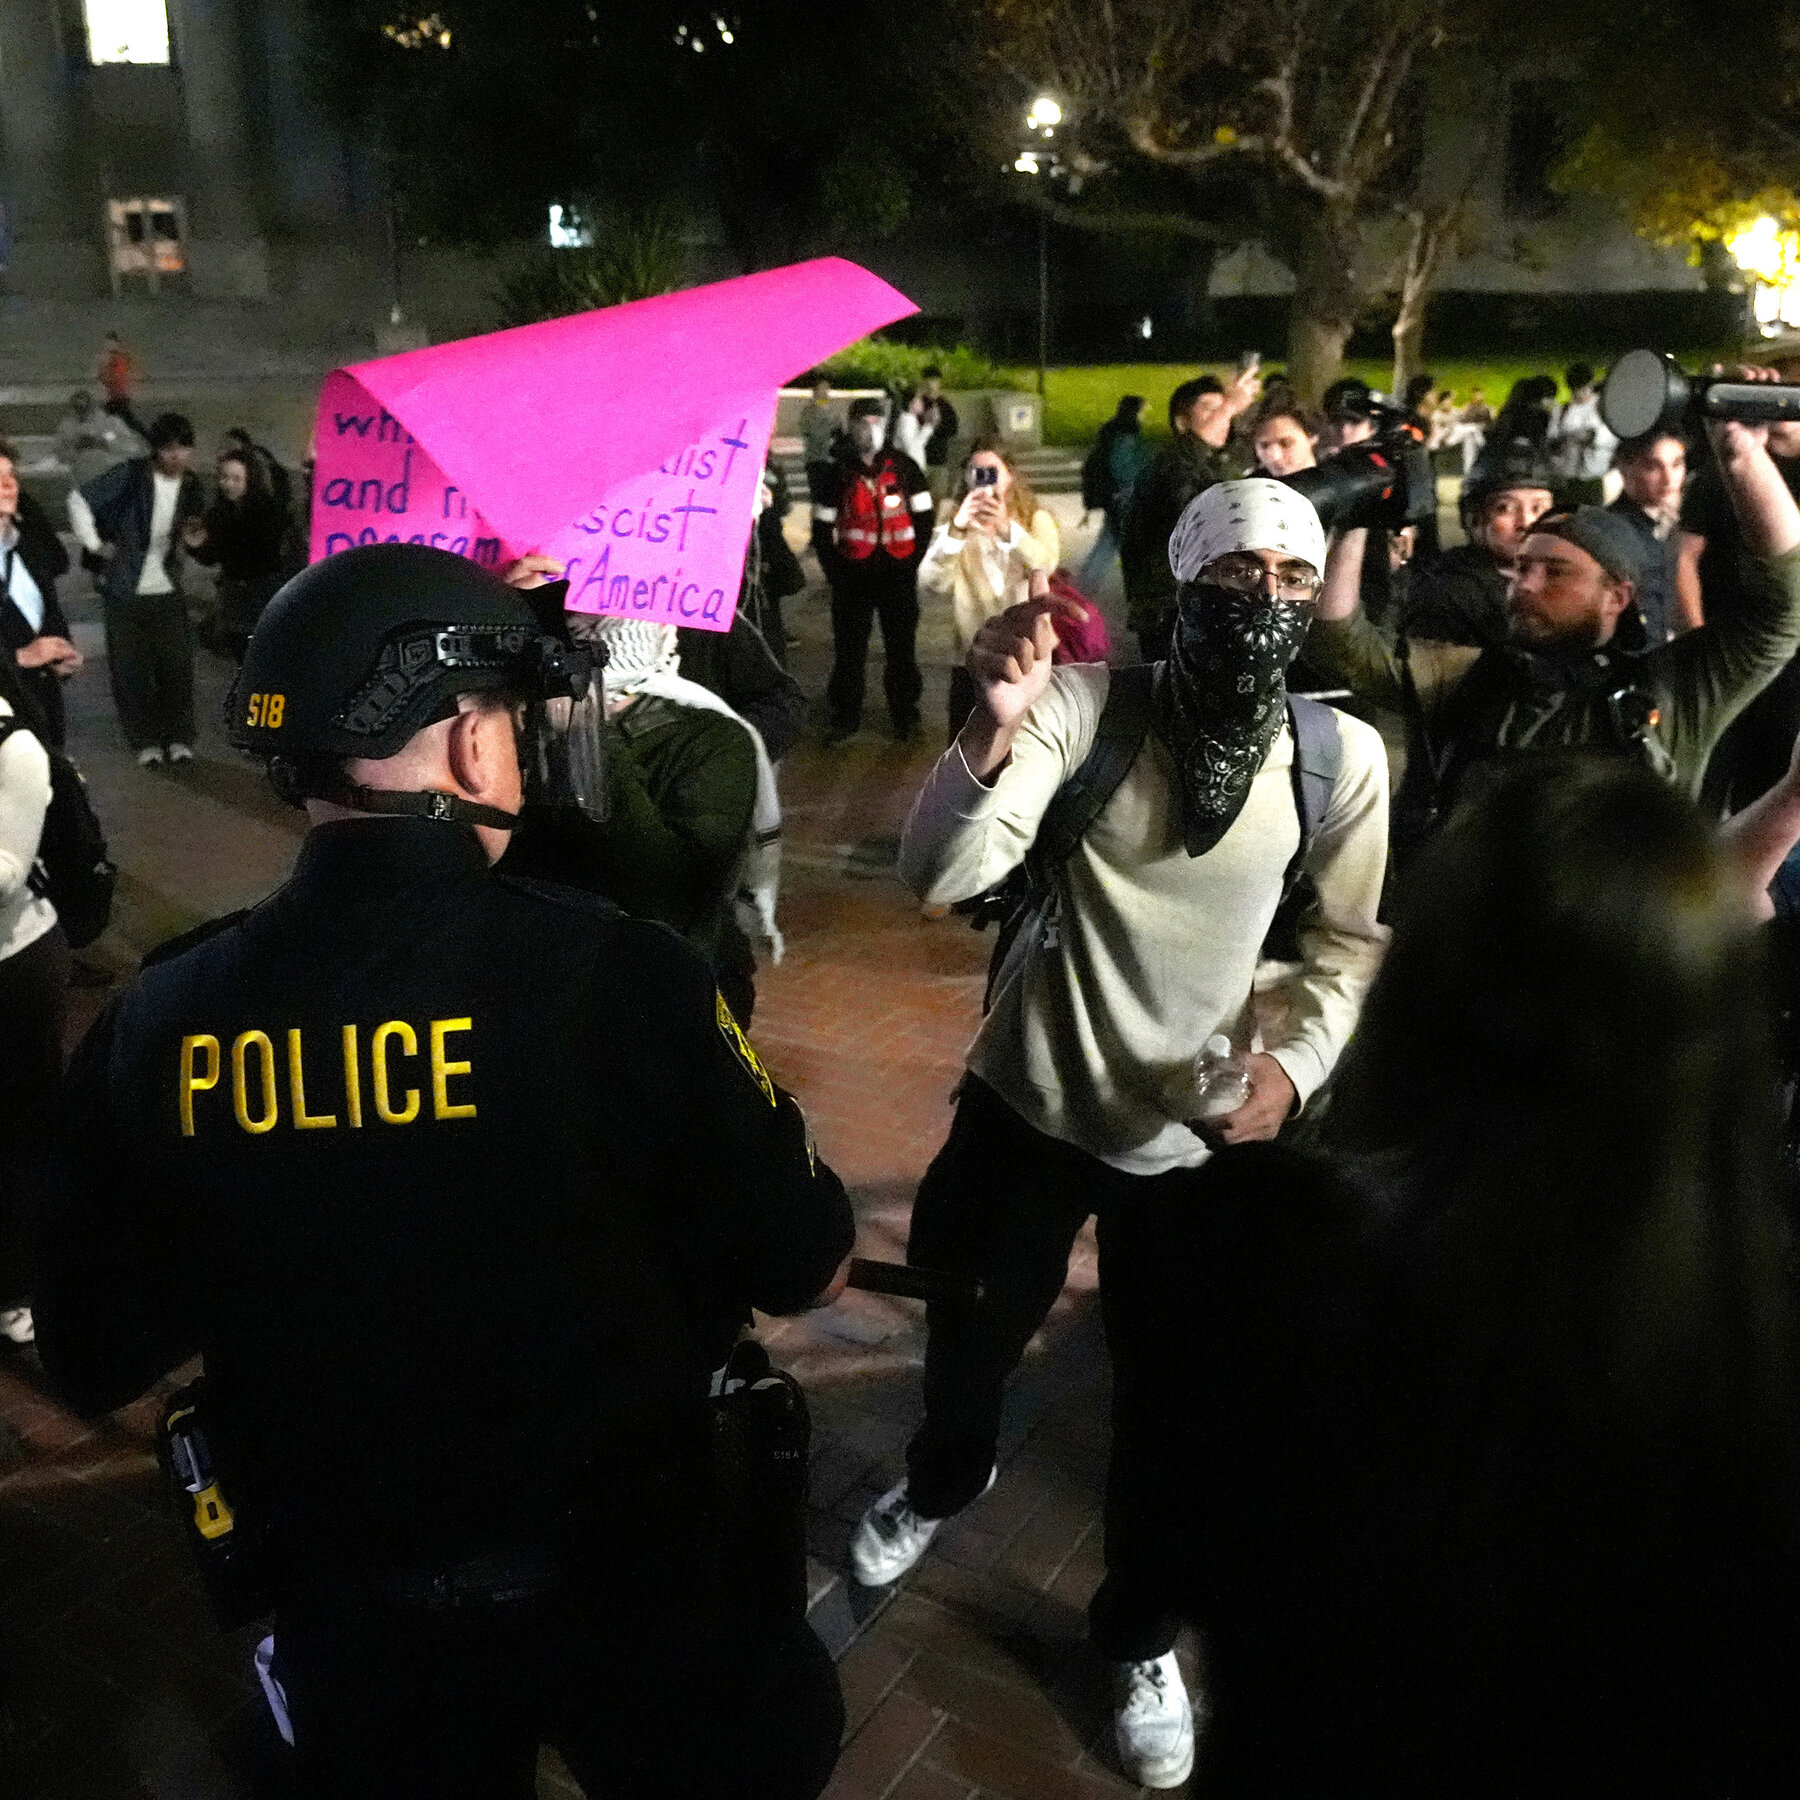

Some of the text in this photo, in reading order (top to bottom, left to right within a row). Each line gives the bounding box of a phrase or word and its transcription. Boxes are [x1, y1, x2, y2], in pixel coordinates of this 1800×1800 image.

[333, 407, 415, 444] wh
[323, 449, 412, 514] and
[572, 488, 718, 552] scist
[571, 543, 721, 623] America
[179, 1017, 478, 1137] POLICE
